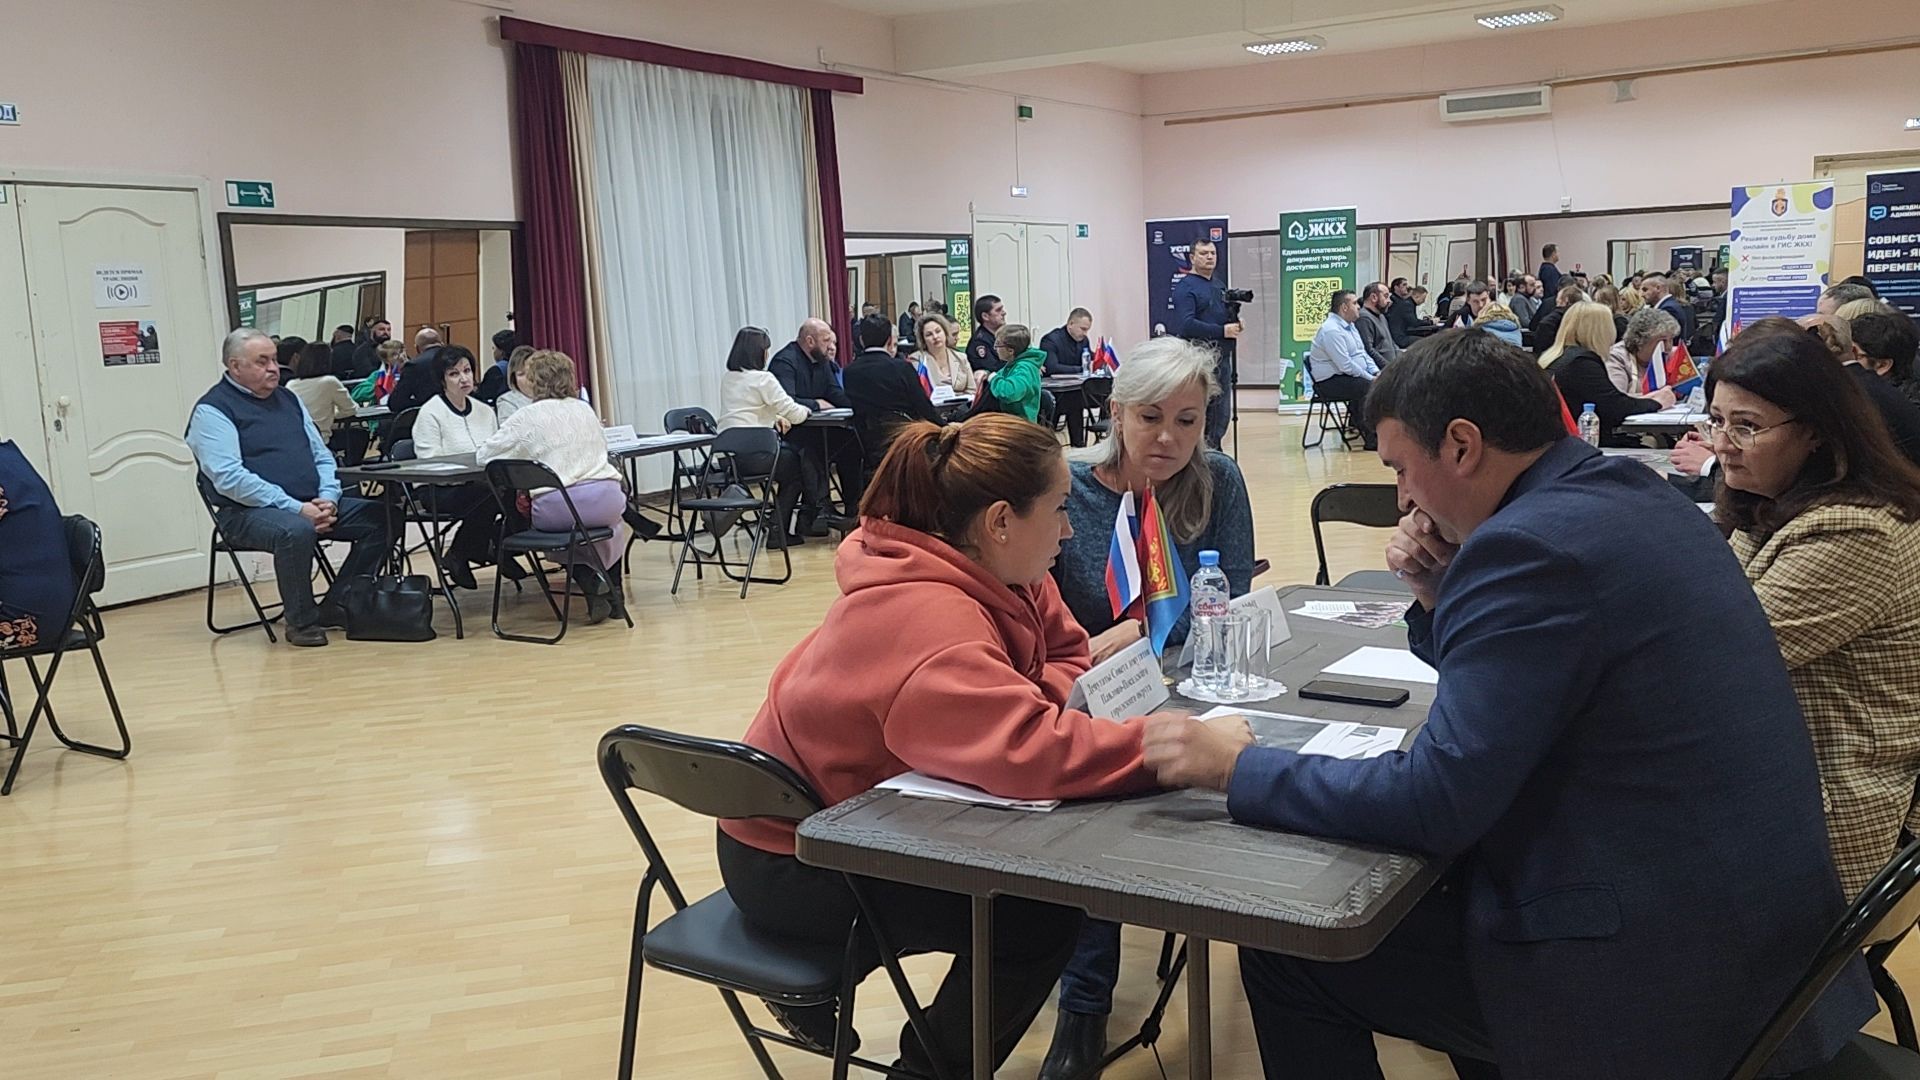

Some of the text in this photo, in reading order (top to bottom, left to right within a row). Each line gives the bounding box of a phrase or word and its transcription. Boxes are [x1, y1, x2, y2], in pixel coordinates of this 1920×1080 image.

[1308, 222, 1347, 236] ЖКХ
[1770, 233, 1796, 243] судьбу
[1282, 247, 1310, 256] Единый
[1310, 245, 1352, 254] платежный
[1867, 249, 1901, 260] ИДЕИ
[1286, 263, 1320, 272] доступен
[1330, 261, 1349, 269] РПГУ
[1867, 263, 1920, 273] ПЕРЕМЕН
